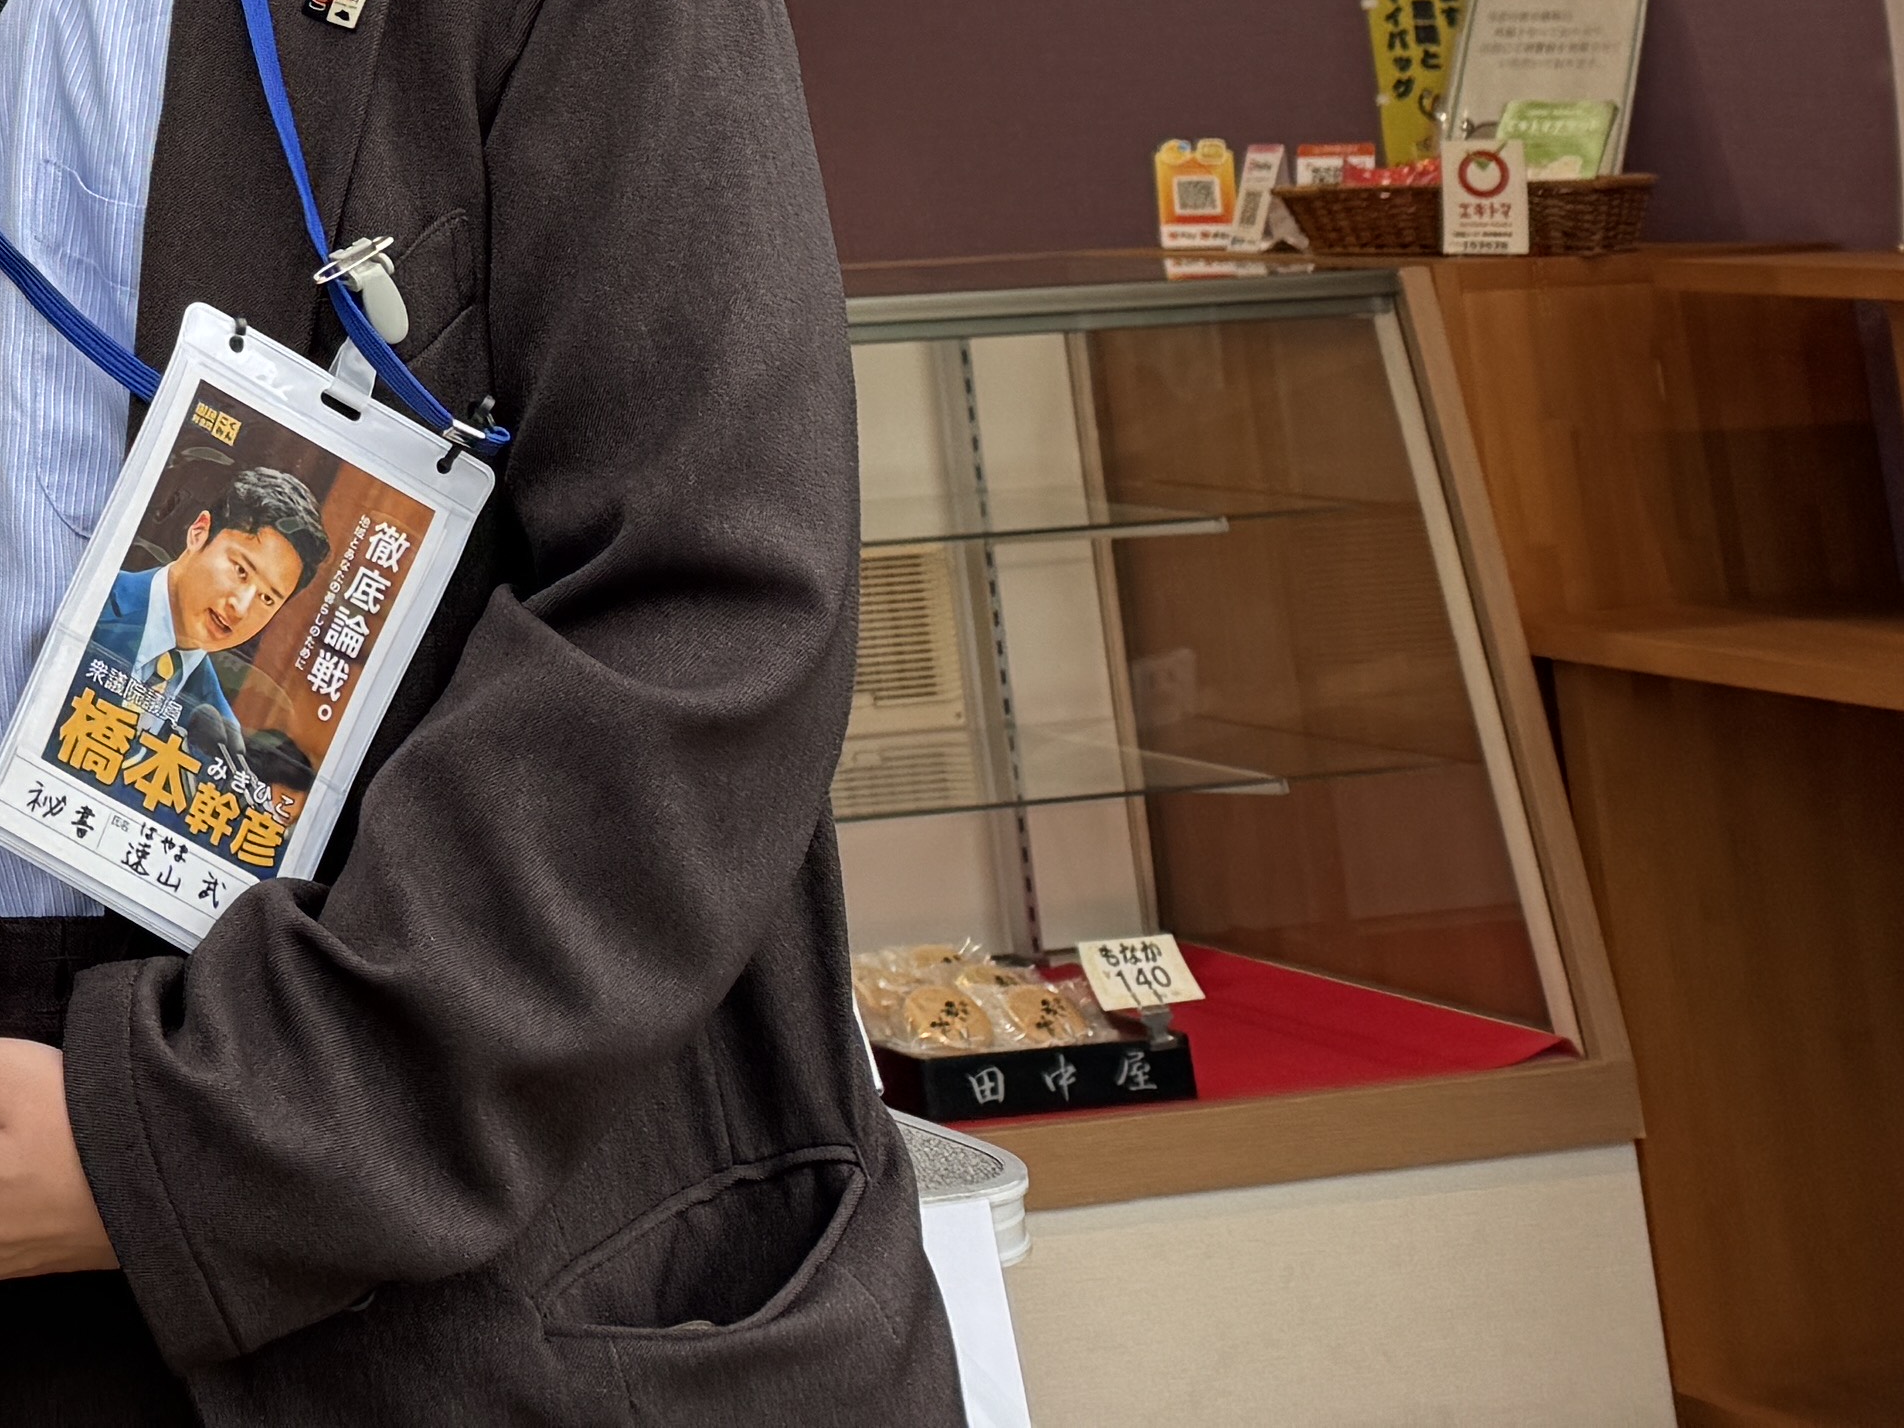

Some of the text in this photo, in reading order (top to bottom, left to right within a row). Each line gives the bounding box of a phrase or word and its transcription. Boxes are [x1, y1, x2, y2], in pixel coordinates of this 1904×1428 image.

[307, 521, 411, 722] 徹底論戦。
[57, 687, 286, 868] 橋本幹彦
[206, 756, 295, 819] みきひこ
[26, 780, 95, 839] 秘書
[1099, 941, 1163, 967] もなか
[968, 1050, 1159, 1104] 田中屋
